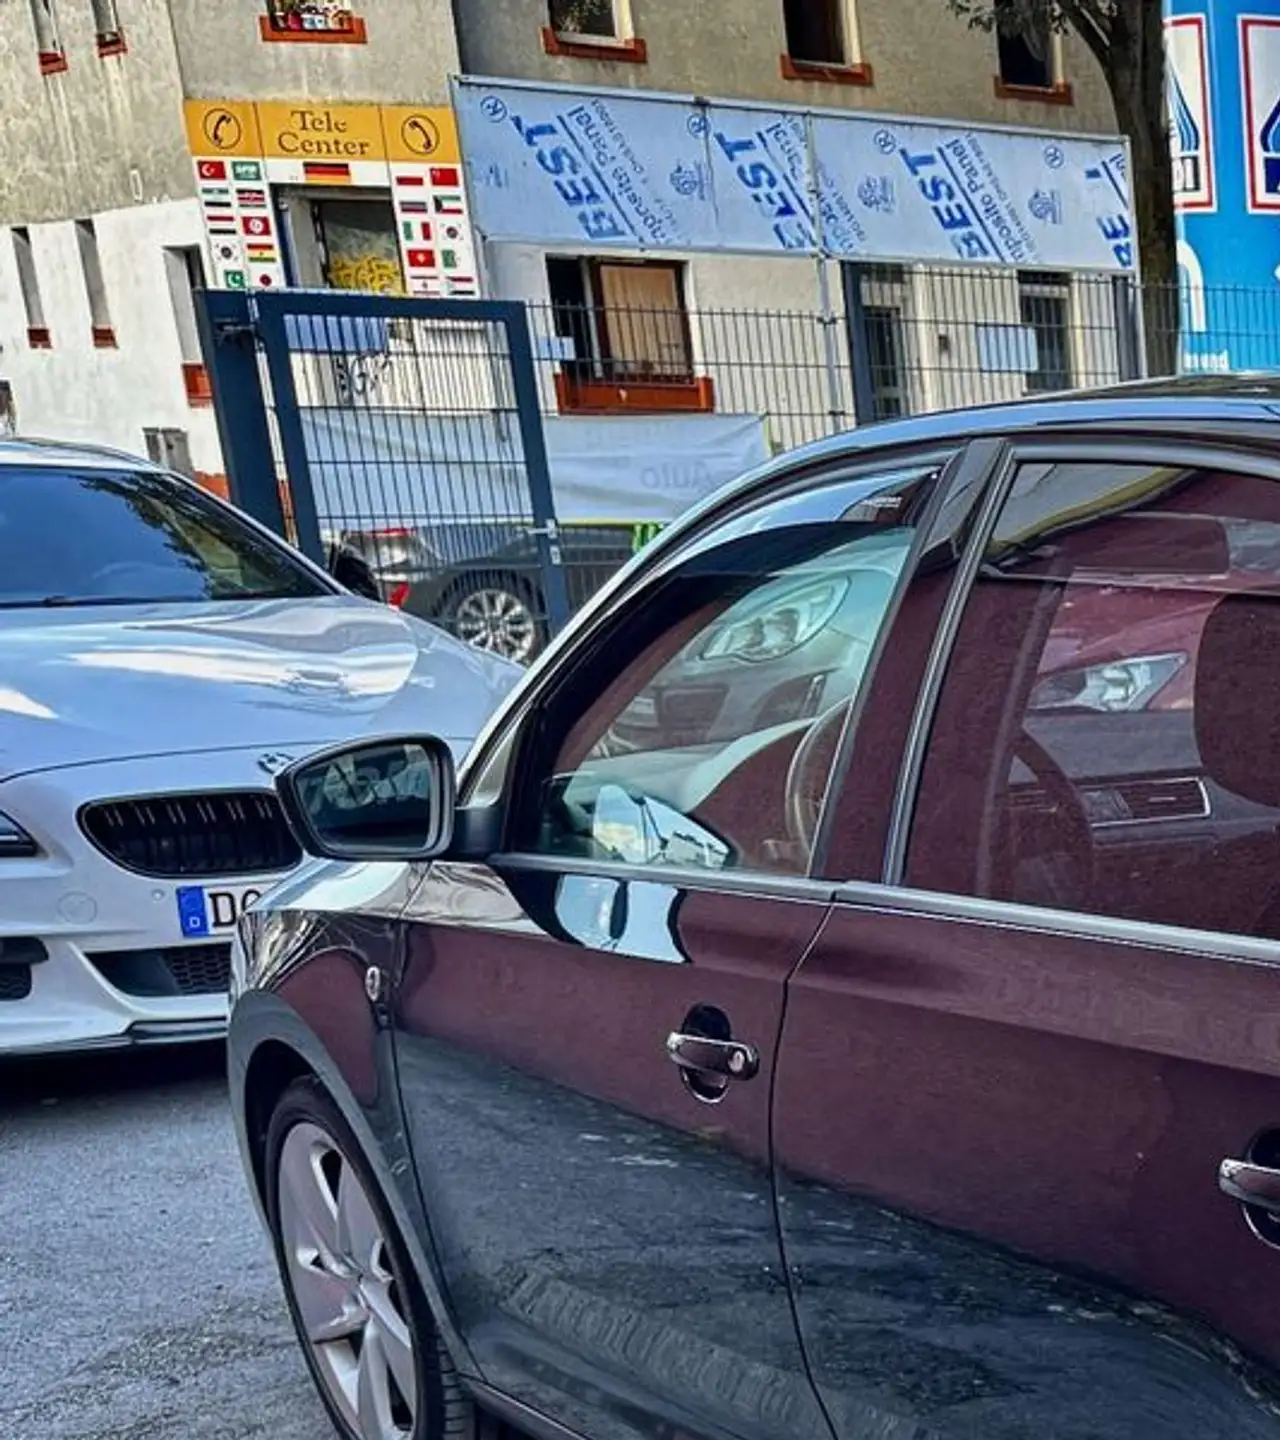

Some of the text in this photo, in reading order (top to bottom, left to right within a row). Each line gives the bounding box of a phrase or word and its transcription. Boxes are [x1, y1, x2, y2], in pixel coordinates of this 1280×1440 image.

[277, 131, 370, 156] Center
[291, 110, 347, 133] Tele
[510, 115, 628, 240] BEST
[944, 138, 983, 194] Panel
[1173, 158, 1196, 191] DI
[899, 147, 990, 259] BEST
